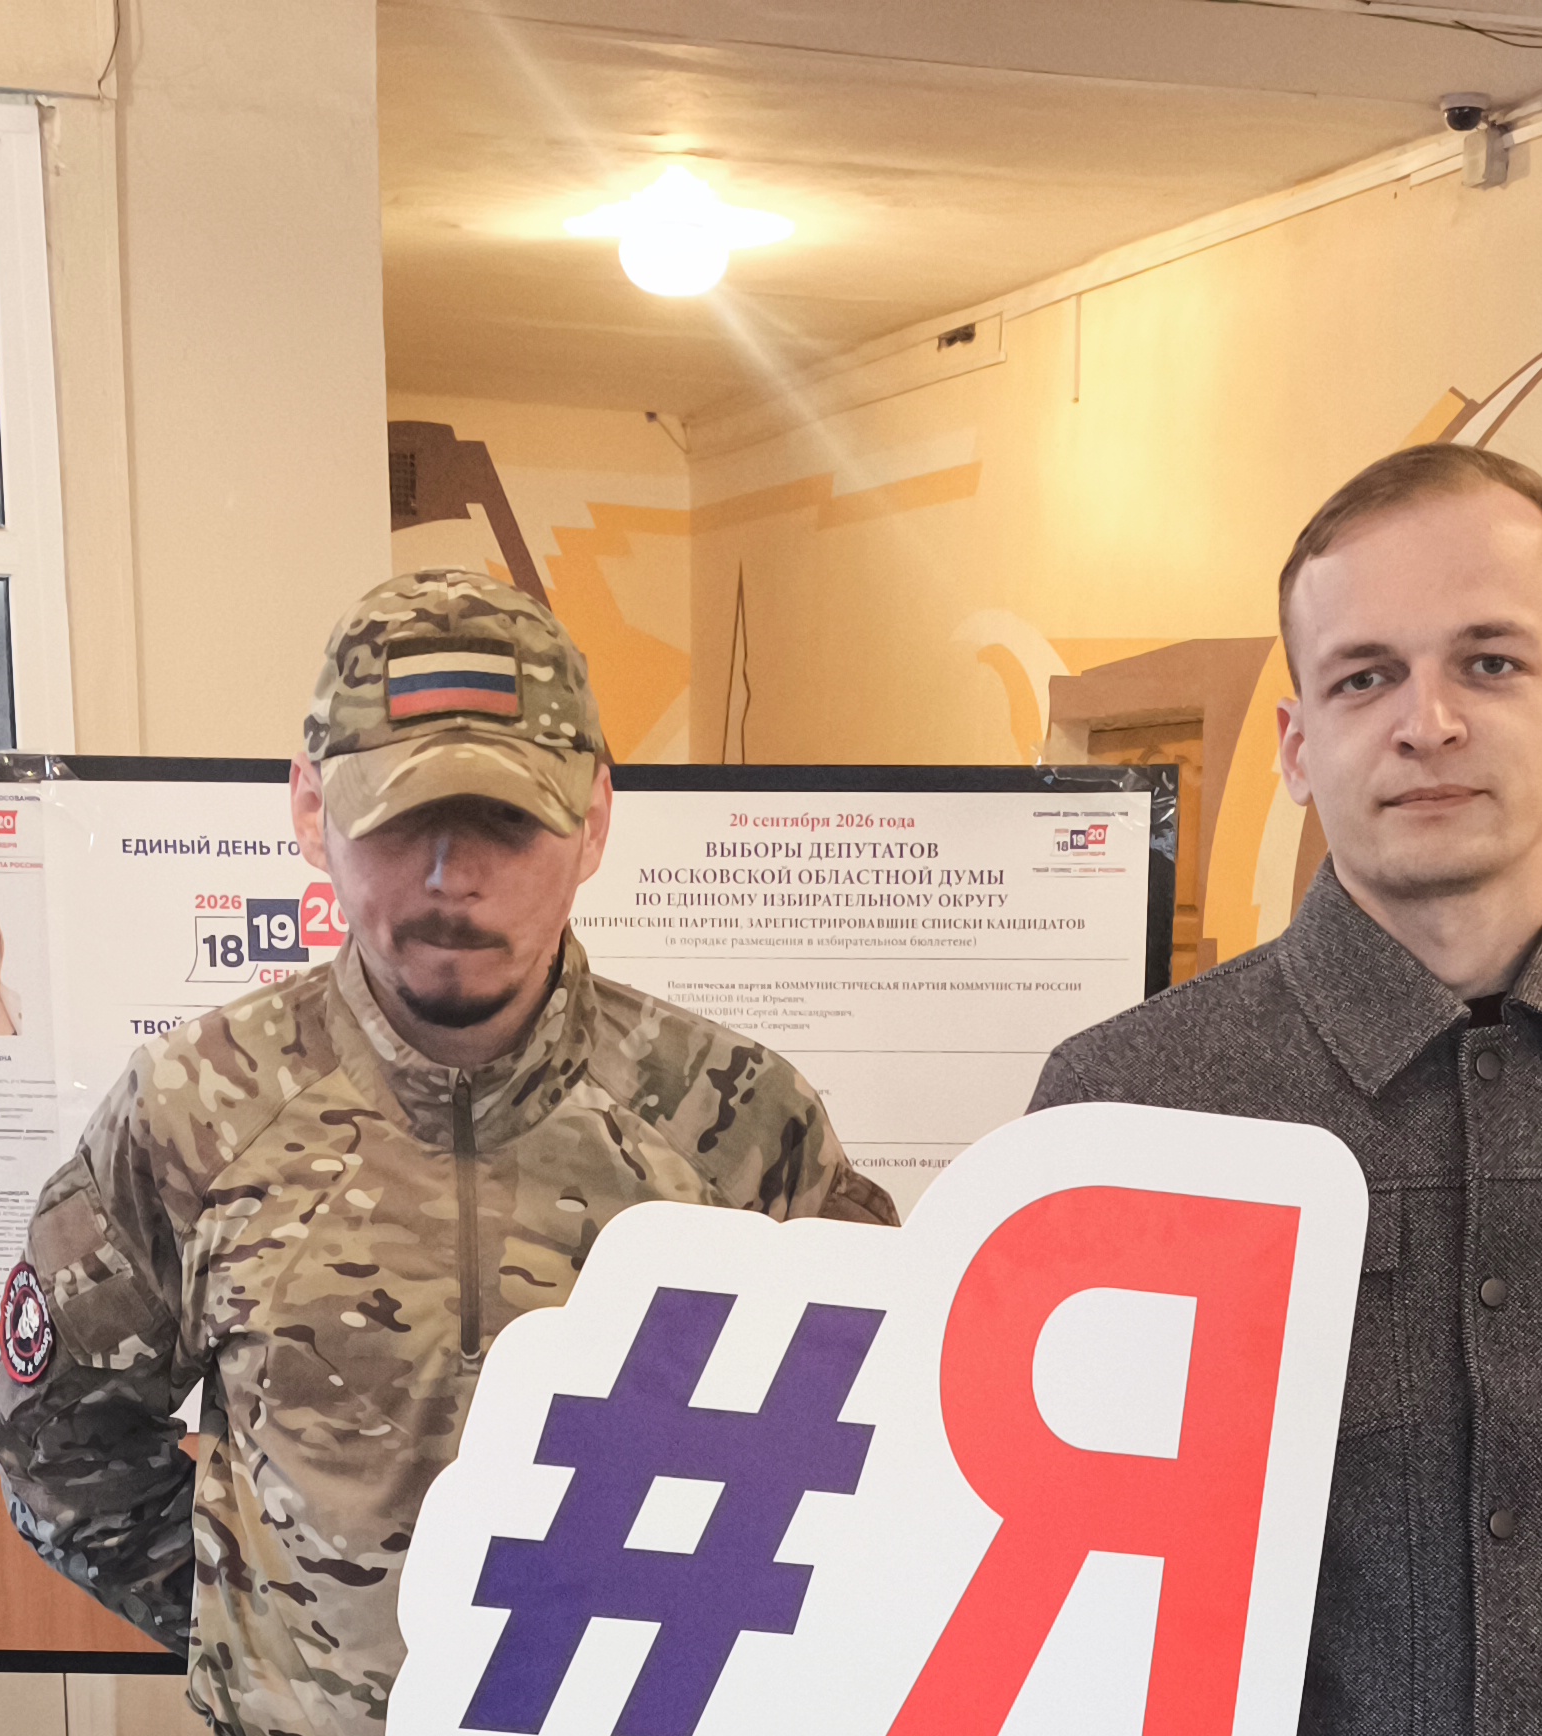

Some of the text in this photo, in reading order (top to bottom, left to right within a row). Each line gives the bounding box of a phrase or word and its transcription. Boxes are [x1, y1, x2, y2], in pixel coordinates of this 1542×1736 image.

[729, 812, 915, 832] 20 сентября 2026 года
[1072, 834, 1085, 846] 19
[1088, 829, 1105, 840] 20
[122, 836, 210, 855] ЕДИНЫЙ
[217, 839, 270, 857] ДЕНЬ
[705, 842, 939, 860] ВЫБОРЫ ДЕПУТАТОВ
[1056, 841, 1068, 852] 18
[638, 865, 1004, 888] МОСКОВСКОЙ ОБЛАСТНОЙ ДУМЫ
[195, 894, 242, 909] 2026
[635, 892, 1008, 908] ПО ЕДИНОМУ ИЗБИРАТЕЛЬНОМУ ОКРУГУ
[305, 897, 349, 932] 20
[569, 916, 675, 928] ОЛИТИЧЕСКИЕ
[746, 917, 918, 929] ЗАРЕГИСТРИРОВАВШИЕ
[922, 918, 983, 929] СПИСКИ
[987, 918, 1086, 930] КАНДИДАТОВ
[252, 914, 296, 950] 19
[731, 938, 803, 949] размещения
[817, 935, 907, 949] избирательном
[202, 934, 245, 968] 18
[775, 981, 899, 991] КОММУНИСТИЧЕСКАЯ
[902, 982, 947, 991] ПАРТИЯ
[950, 982, 1033, 991] КОММУНИСТЫ
[1035, 982, 1082, 991] РОССИИ
[851, 1157, 916, 1167] ОССИЙСКОЙ
